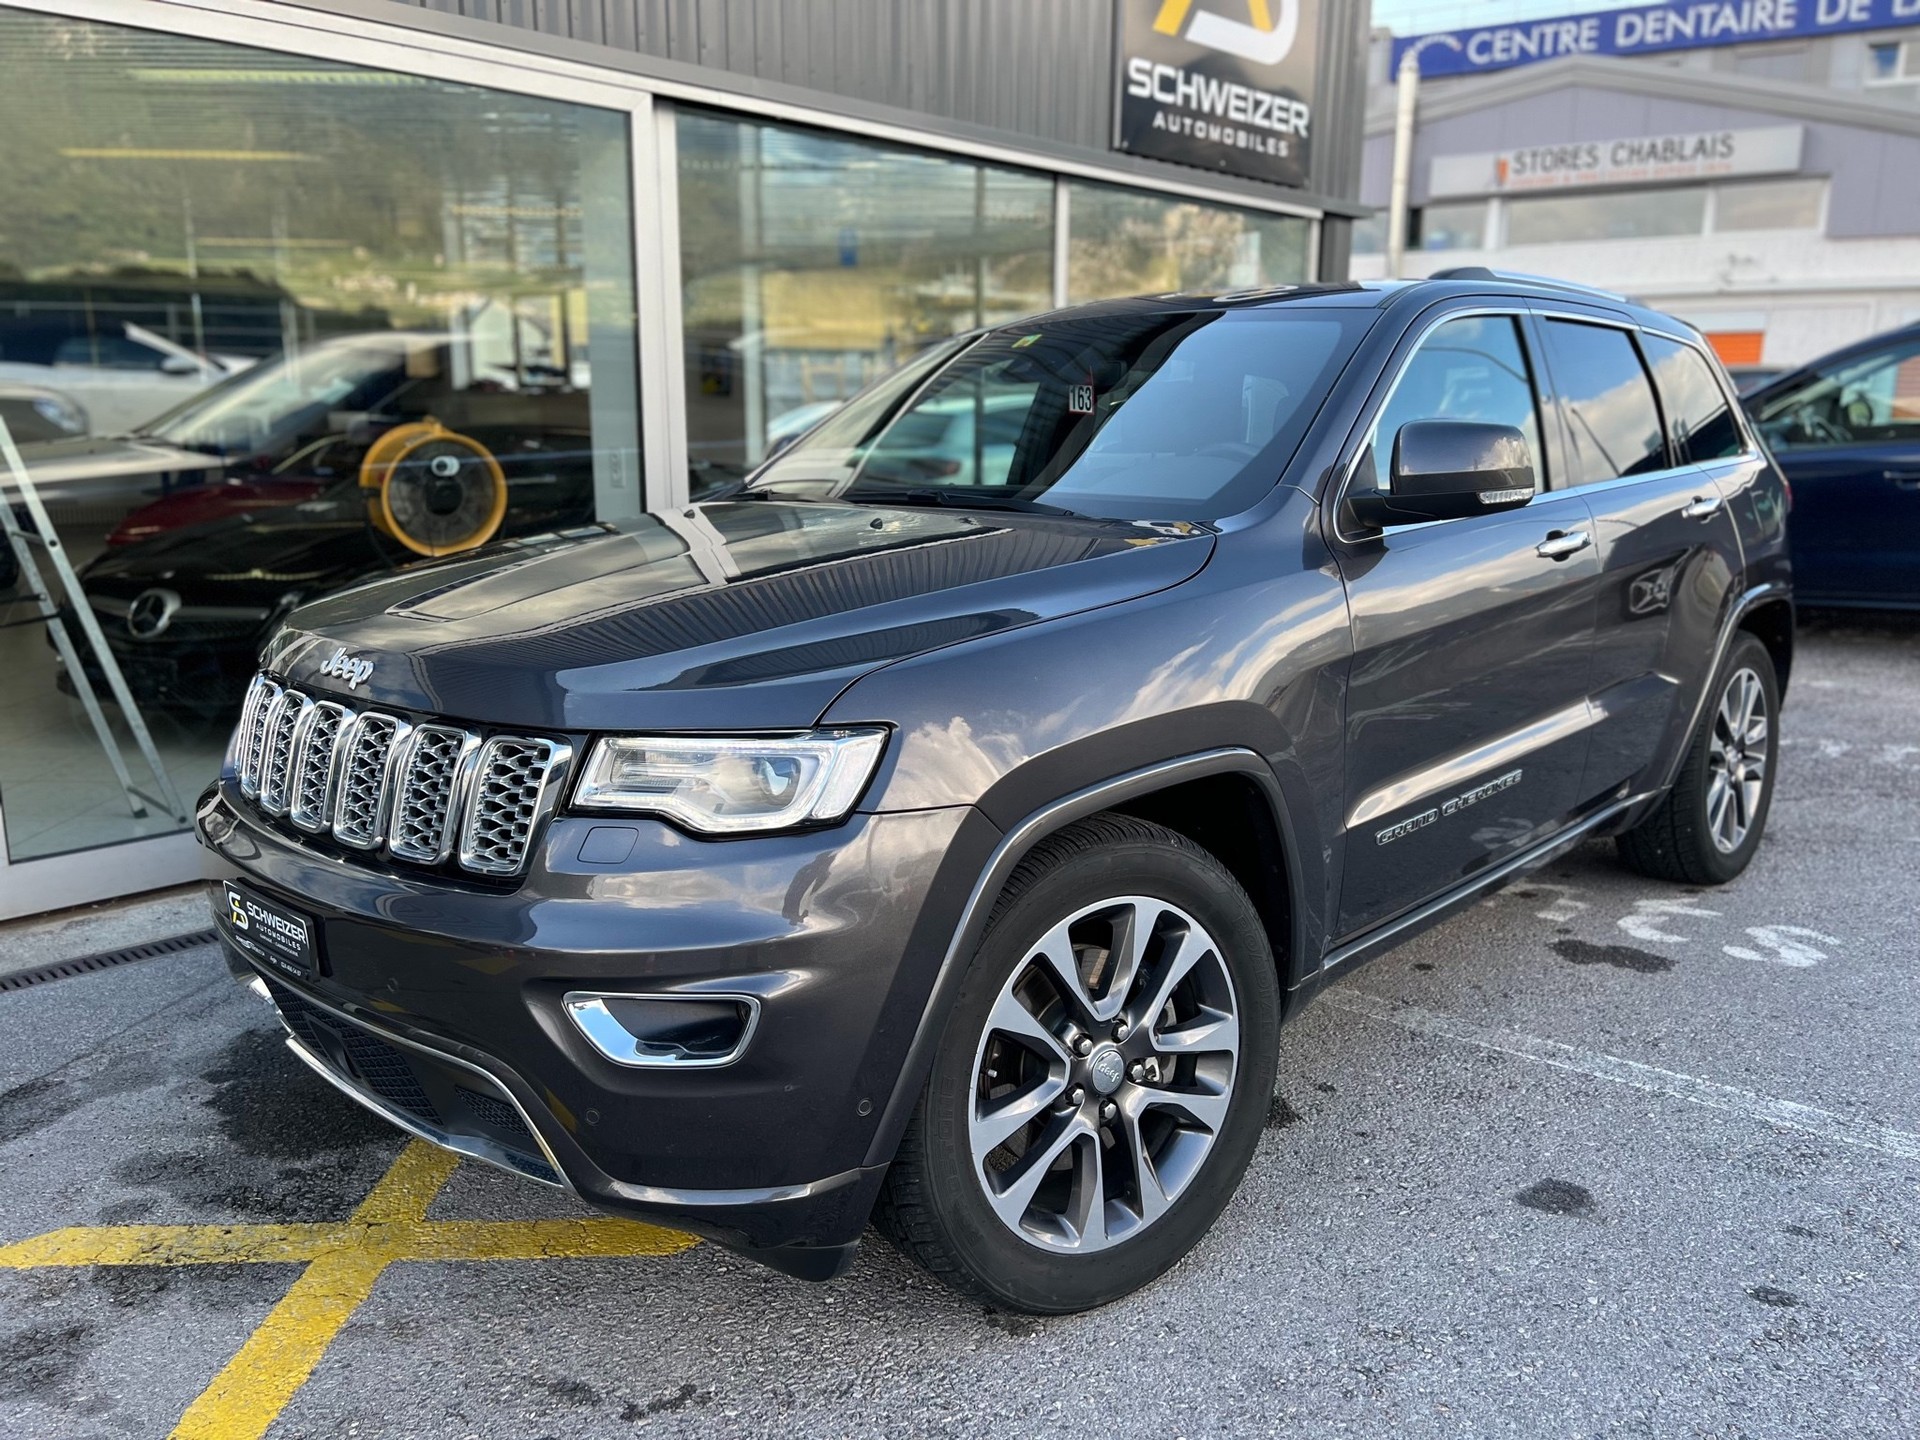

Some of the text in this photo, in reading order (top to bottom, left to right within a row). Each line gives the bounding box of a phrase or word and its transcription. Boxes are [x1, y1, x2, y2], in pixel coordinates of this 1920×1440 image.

[1466, 17, 1600, 65] CENTRE
[1615, 0, 1797, 47] DENTAIRE
[1128, 57, 1310, 138] SCHWEIZER
[1152, 111, 1289, 157] AUTOMOBILES
[1513, 133, 1734, 175] STORES CHABLAIS
[1070, 386, 1092, 411] 163
[320, 647, 375, 690] Jeep
[1375, 769, 1523, 845] GRAND CHEROKEE
[246, 901, 306, 944] SCHWEIZER
[256, 922, 301, 951] AUTOMOBILES
